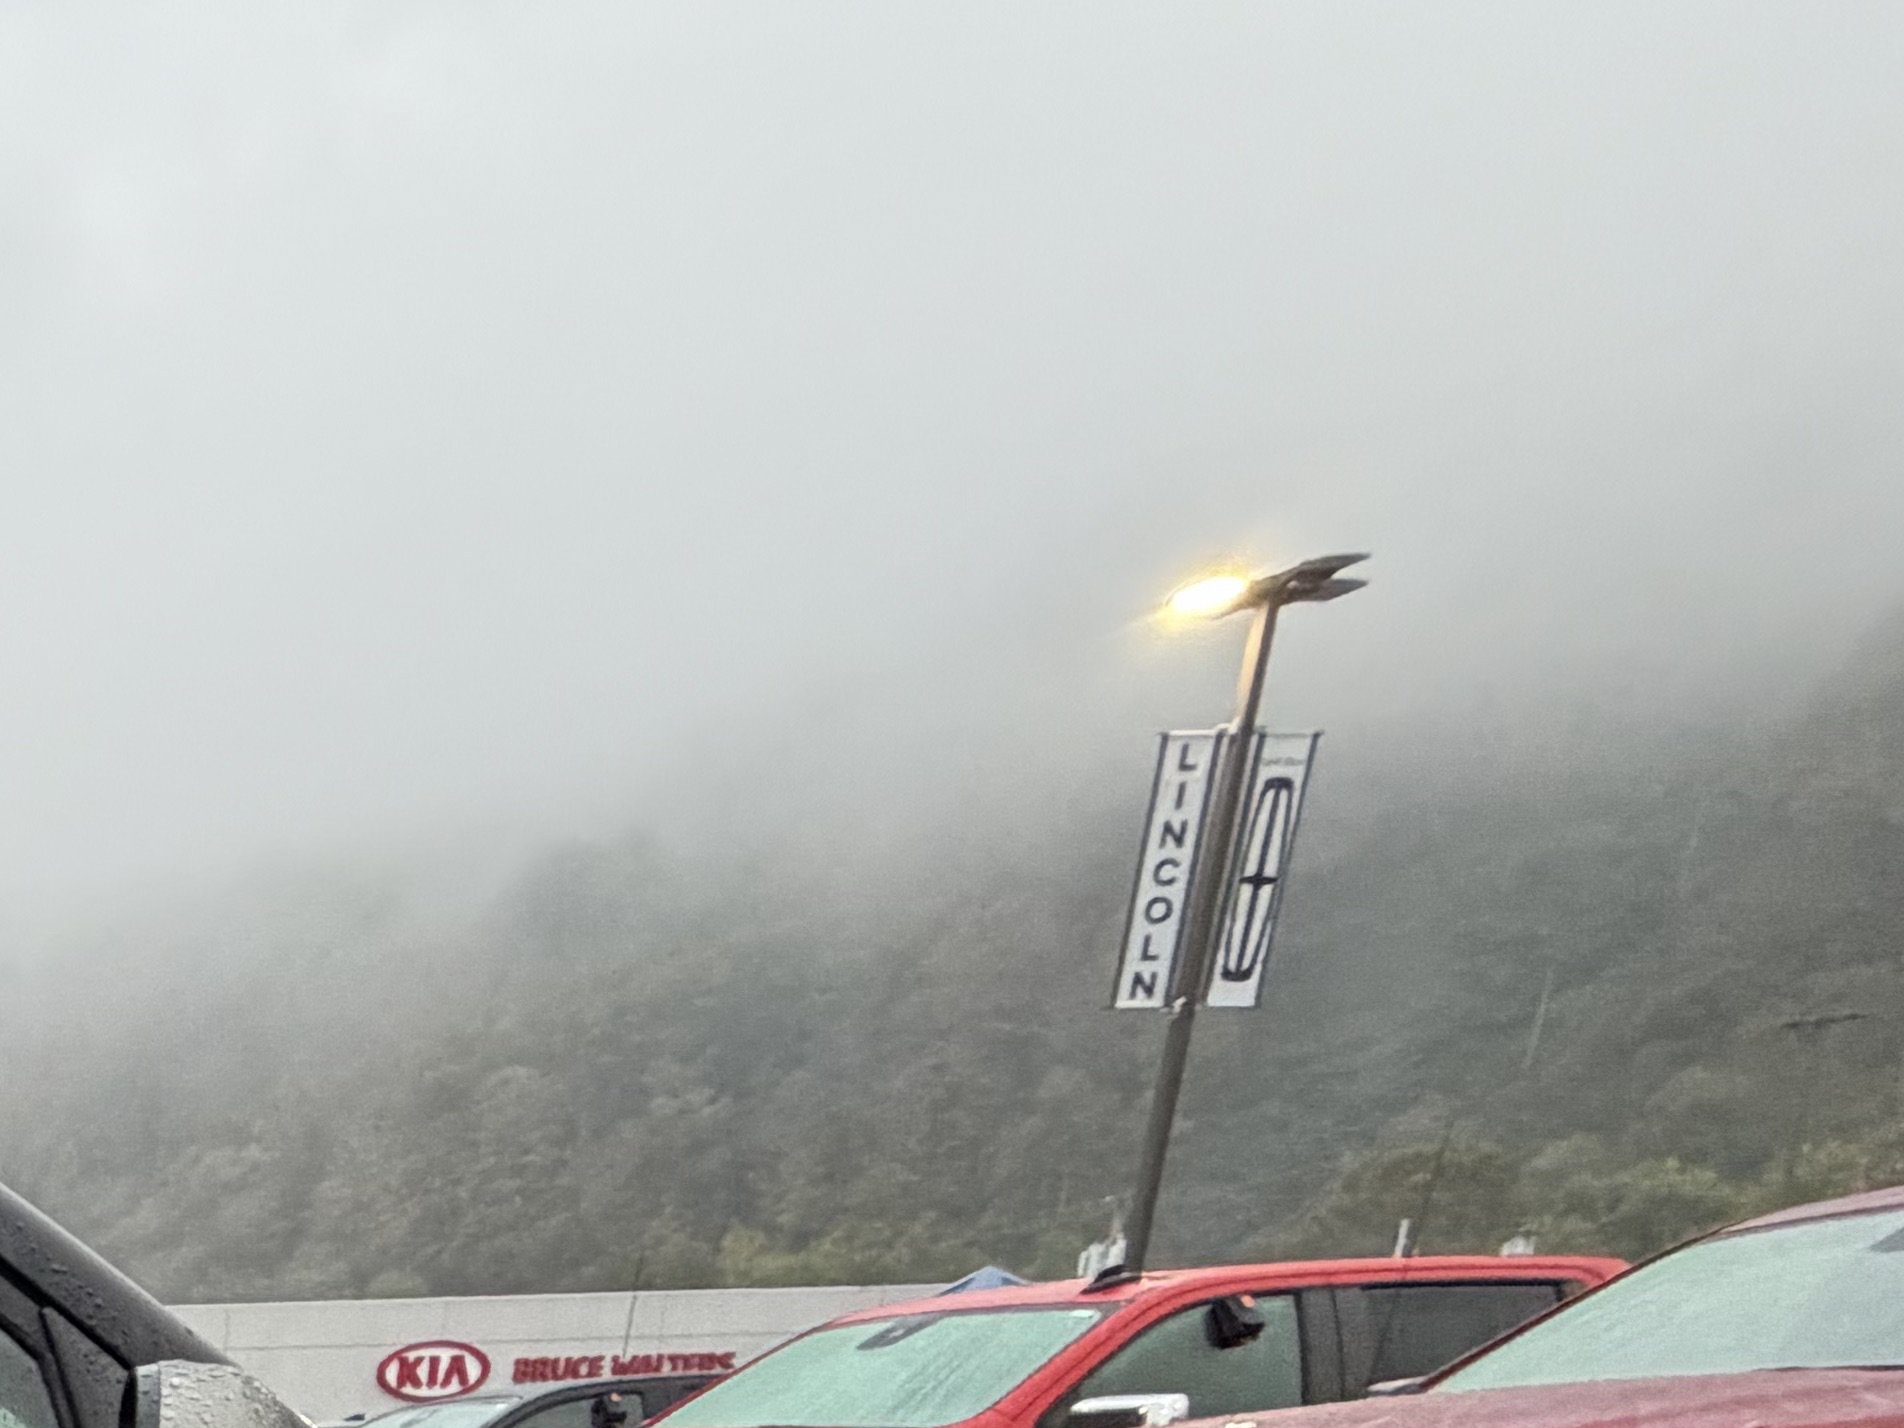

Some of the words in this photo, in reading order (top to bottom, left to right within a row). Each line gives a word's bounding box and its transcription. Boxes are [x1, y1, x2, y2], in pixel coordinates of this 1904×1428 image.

[1128, 743, 1197, 1000] LINCOLN
[393, 1355, 473, 1389] KIA
[512, 1355, 605, 1384] BRUCE
